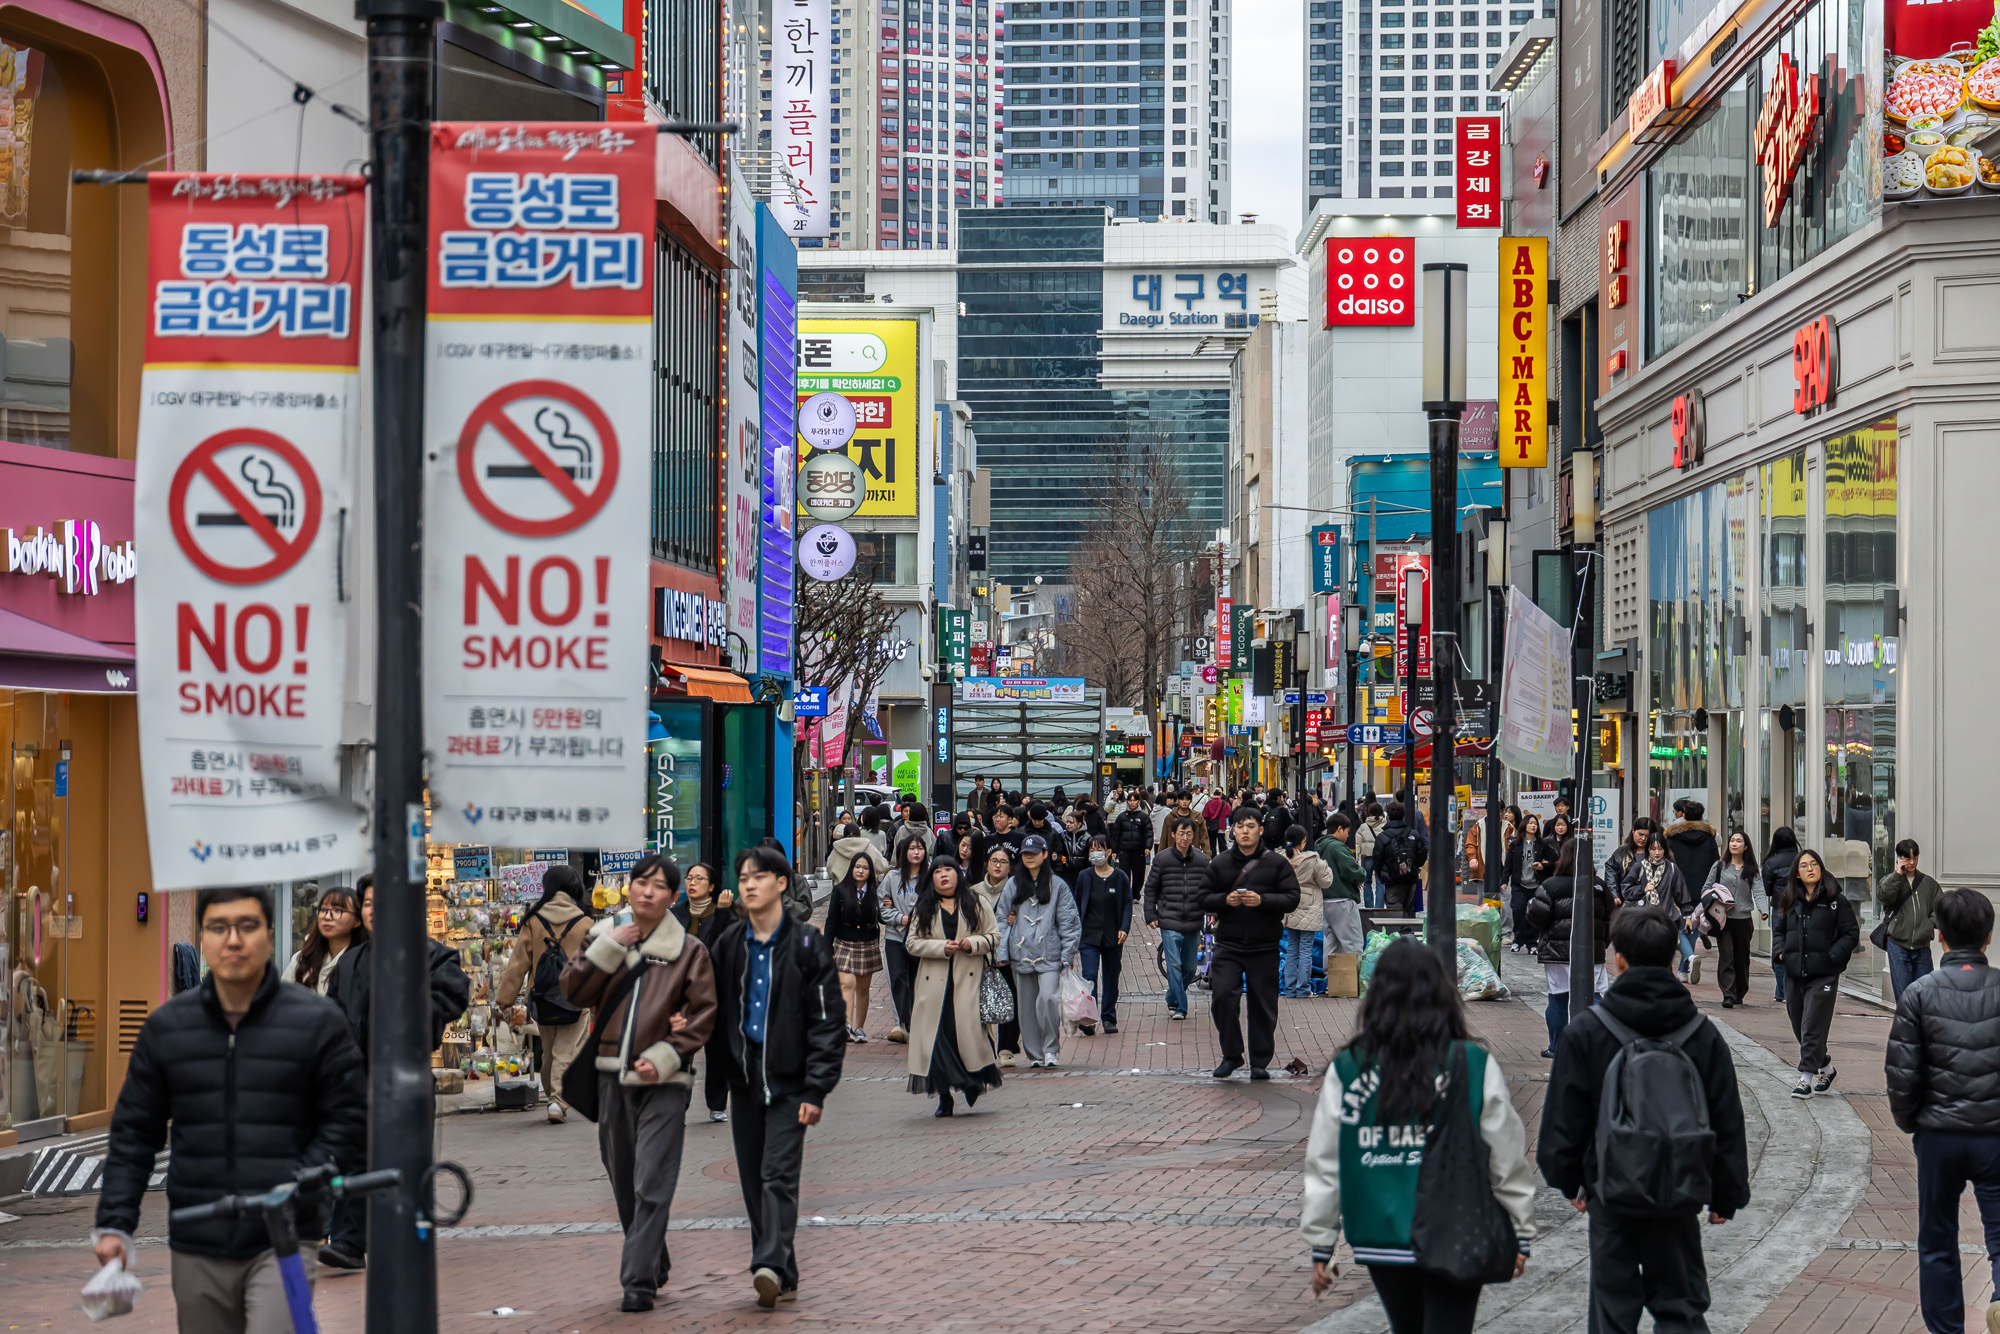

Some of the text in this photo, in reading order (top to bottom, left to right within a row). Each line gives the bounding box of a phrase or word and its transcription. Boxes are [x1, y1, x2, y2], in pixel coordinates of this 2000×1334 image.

[1466, 124, 1492, 220] 금강제화
[465, 172, 620, 230] 동성로
[793, 220, 807, 231] 2F
[180, 223, 329, 279] 동성로
[439, 231, 644, 290] 금연거리
[1132, 272, 1248, 311] 대구역
[1338, 294, 1405, 315] daiso
[155, 281, 351, 338] 금연거리
[1119, 311, 1219, 328] Daegu Station
[797, 338, 832, 368] 폰
[1512, 246, 1535, 459] ABC-MART
[1794, 314, 1831, 416] SPAO
[797, 377, 885, 390] 후기를 확인하세요!
[157, 391, 187, 407] CGV
[811, 428, 845, 436] 푸라닭 치킨
[1672, 387, 1698, 470] SPAO
[806, 470, 856, 495] 동성당
[8, 526, 64, 579] baskin
[809, 558, 844, 567] 한끼플러스
[1322, 546, 1333, 587] 7번가피자
[463, 554, 612, 627] NO!
[177, 602, 311, 674] NO!
[463, 634, 609, 671] SMOKE
[178, 680, 307, 718] SMOKE
[469, 706, 602, 731] 흡연시 5만원의
[446, 735, 624, 758] 과태료가 부과됩니다
[938, 707, 947, 763] 지하철 출입구
[190, 750, 244, 773] 흡연시
[170, 776, 243, 798] 과태료가
[488, 805, 612, 824] 대구광역시 중구
[657, 752, 674, 853] GAMES
[218, 832, 339, 860] 대구광역시 중구
[603, 852, 641, 862] 1개 5900원
[456, 858, 478, 868] 7900원
[608, 862, 621, 870] 2개
[1358, 1126, 1384, 1149] OF
[1361, 1152, 1405, 1168] Optical
